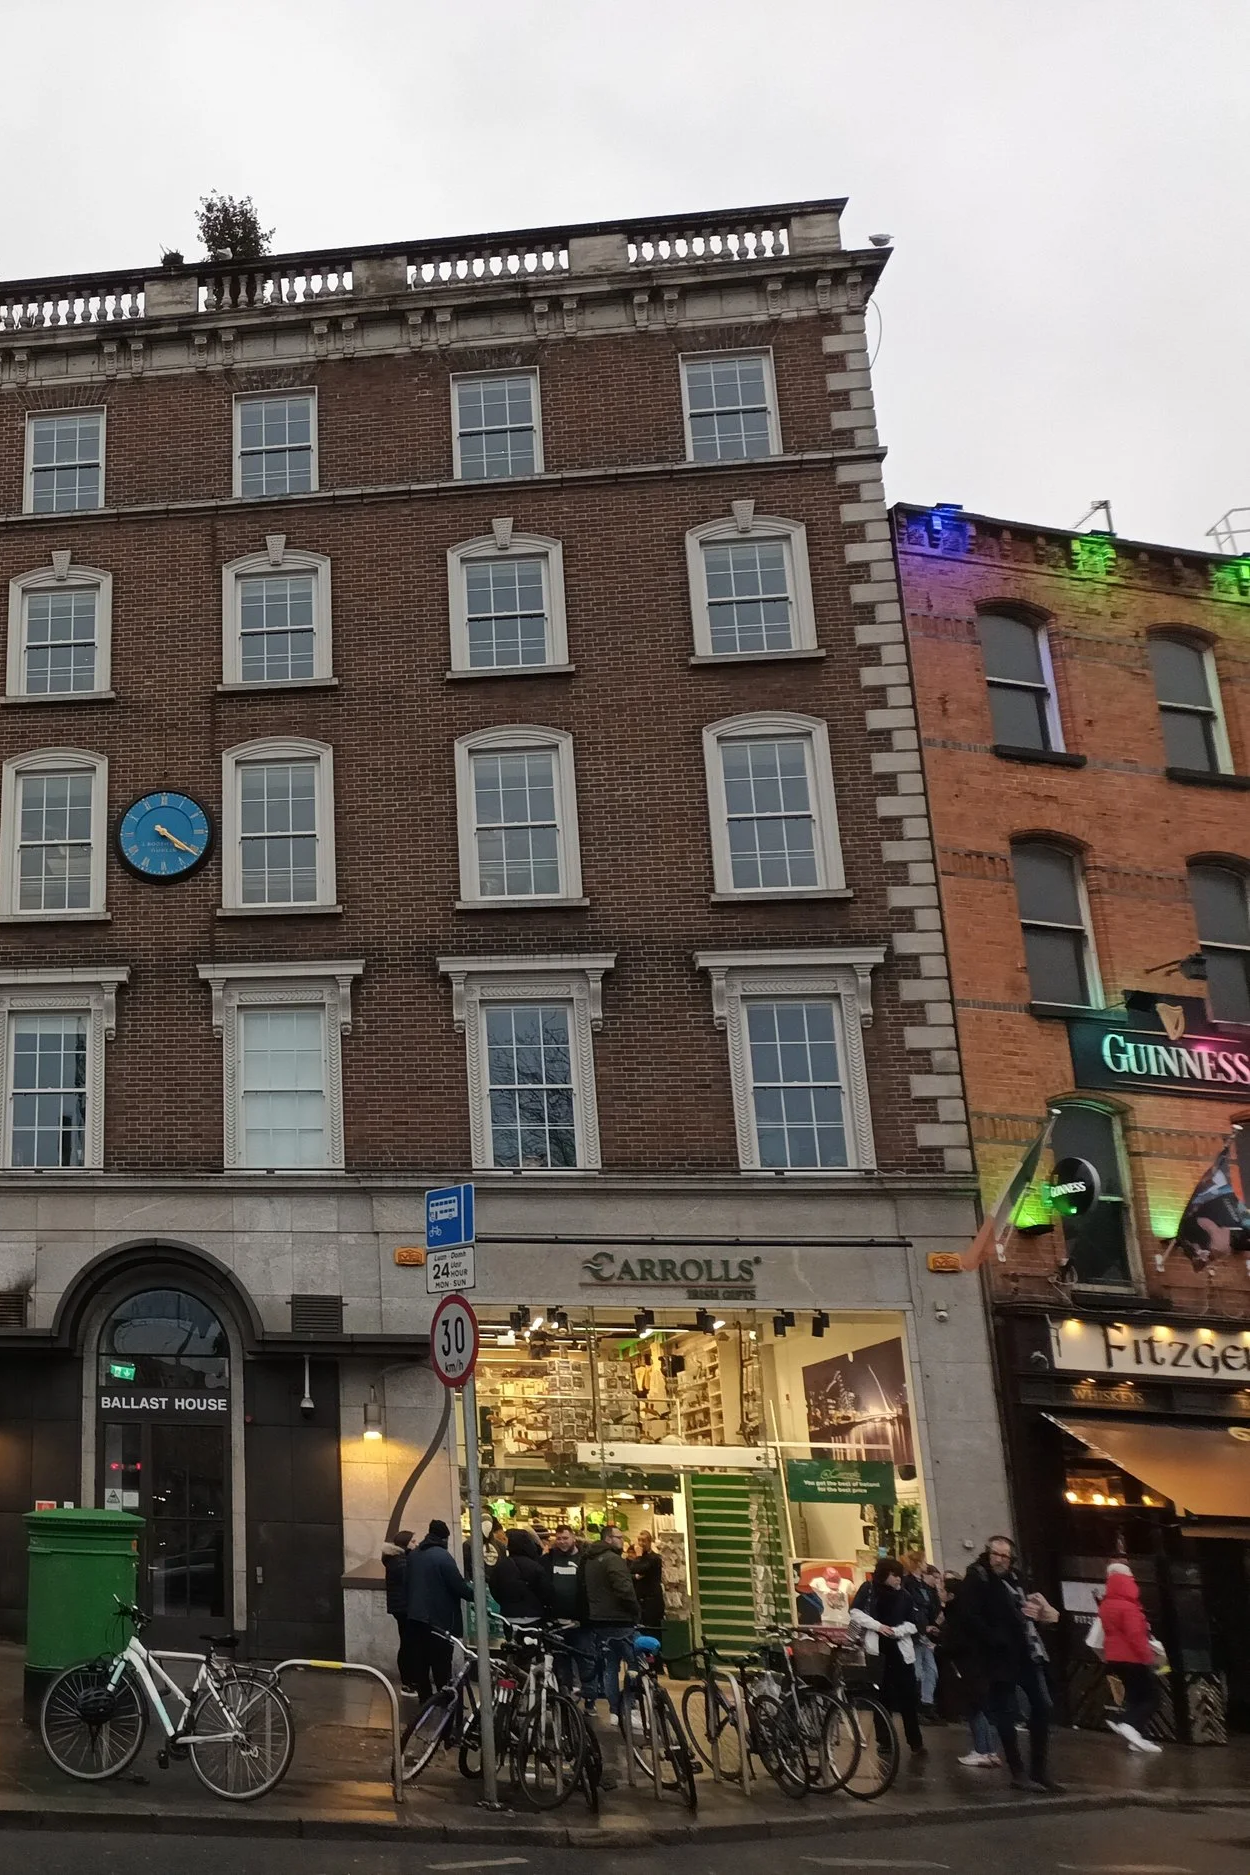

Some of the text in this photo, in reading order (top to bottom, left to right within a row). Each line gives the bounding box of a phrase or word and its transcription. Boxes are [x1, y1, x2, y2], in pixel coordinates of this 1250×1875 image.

[1102, 1033, 1250, 1085] GUINNESS
[432, 1262, 450, 1280] 24
[450, 1268, 468, 1278] HOUR
[583, 1251, 755, 1283] CARROLLS
[435, 1279, 467, 1289] MON SUN
[686, 1289, 757, 1300] IRISH GIFTS
[441, 1316, 465, 1357] 30
[444, 1358, 464, 1373] km/h
[1071, 1387, 1145, 1404] WHISKEYS
[101, 1396, 228, 1412] BALLAST HOUSE
